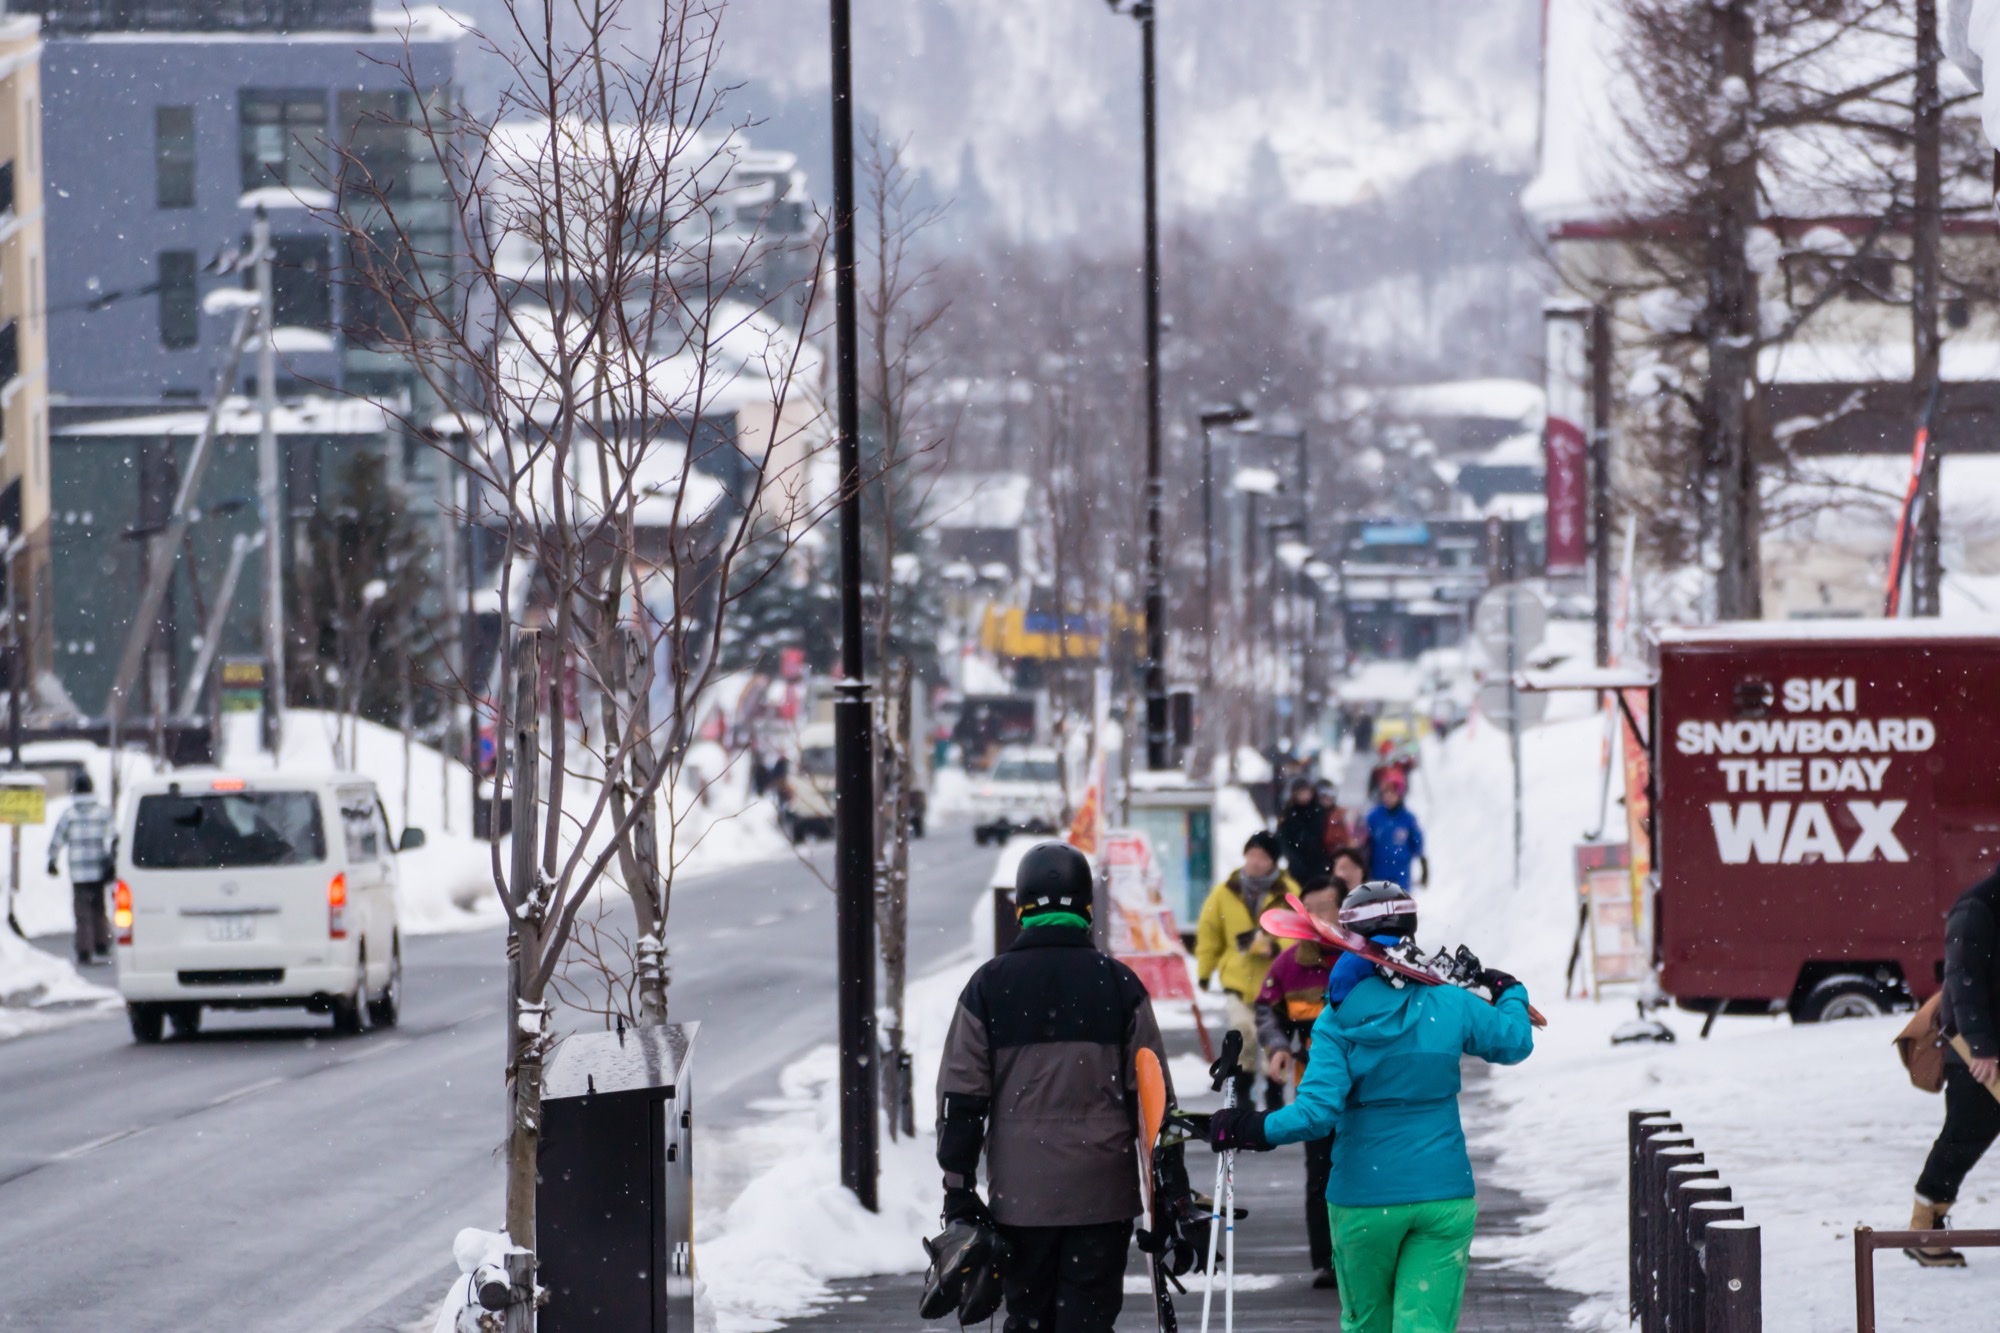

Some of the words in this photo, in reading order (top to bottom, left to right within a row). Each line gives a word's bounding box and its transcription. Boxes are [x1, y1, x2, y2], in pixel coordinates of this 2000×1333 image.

[1782, 678, 1857, 712] SKI
[1676, 718, 1936, 754] SNOWBOARD
[1718, 758, 1803, 792] THE
[1809, 758, 1892, 791] DAY
[1708, 801, 1910, 864] WAX
